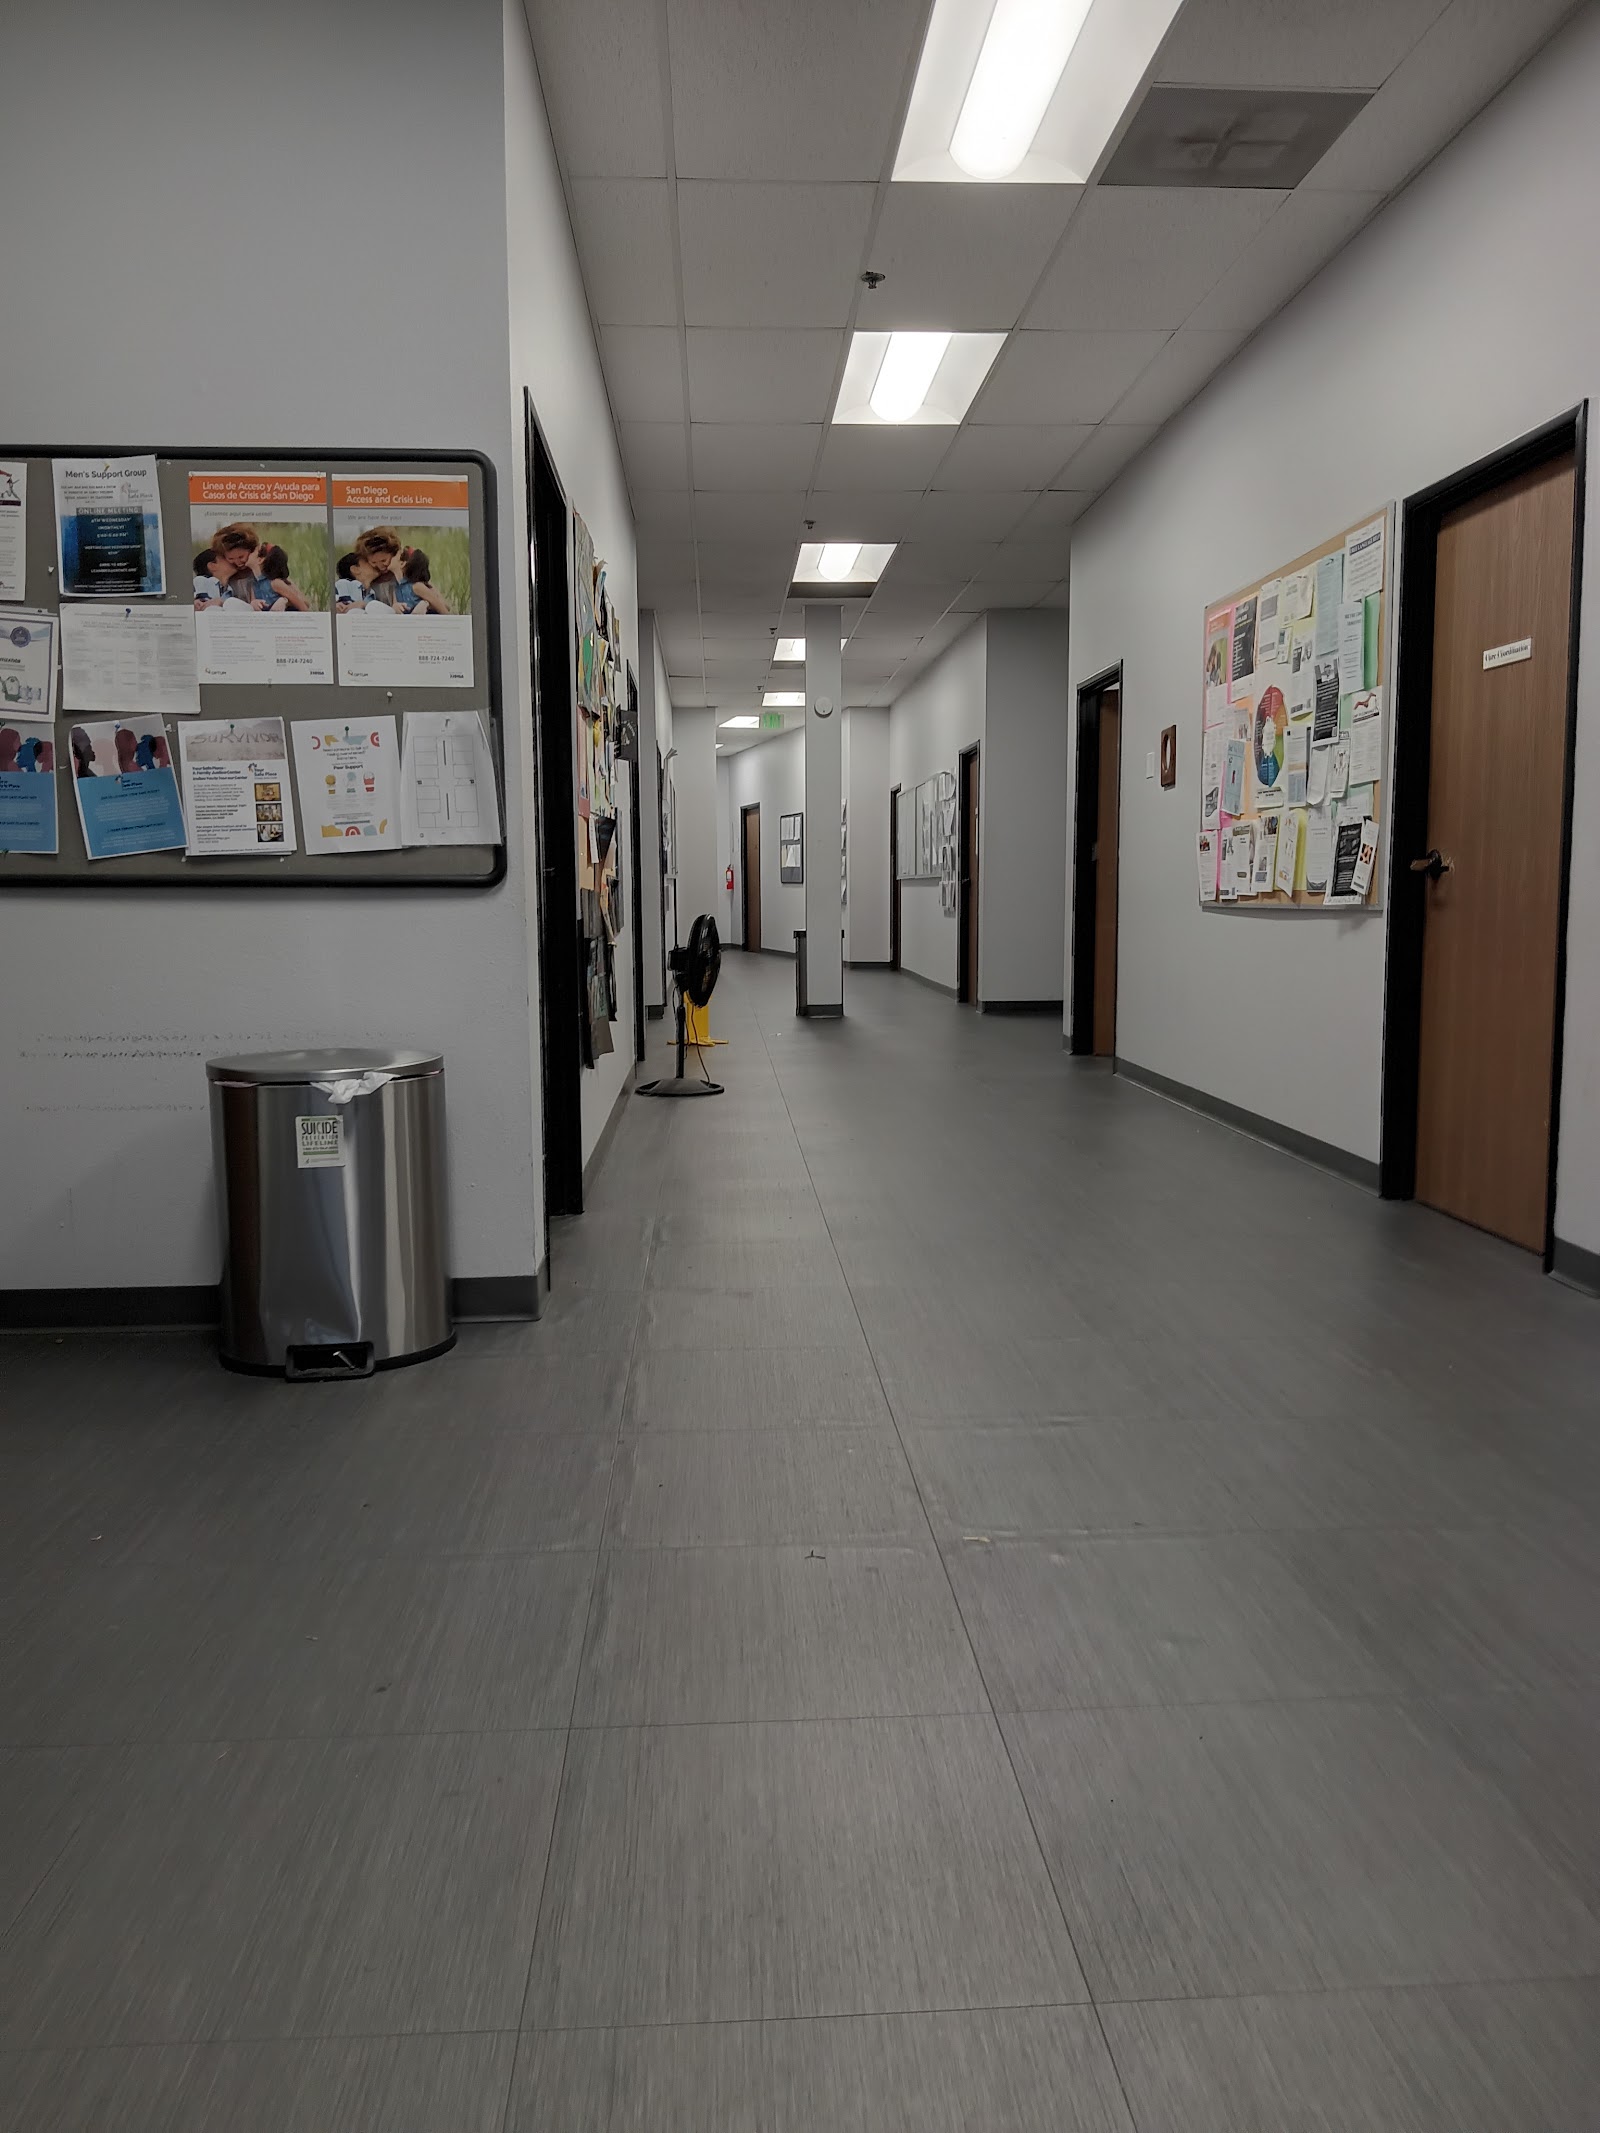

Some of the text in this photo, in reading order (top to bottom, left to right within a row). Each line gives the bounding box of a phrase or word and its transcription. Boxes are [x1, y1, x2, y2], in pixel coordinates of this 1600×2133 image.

[65, 469, 147, 480] Men's Support Group
[225, 481, 236, 490] de
[238, 482, 265, 491] Acceso
[267, 484, 273, 492] y
[273, 482, 300, 492] Ayuda
[301, 483, 320, 492] para
[346, 486, 388, 497] San Diego
[202, 490, 314, 502] Casos de Crisis de San Diego
[346, 495, 433, 504] Access and Crisis Line
[78, 506, 139, 516] ONLINE MEETING
[301, 1121, 338, 1135] SUICIDE
